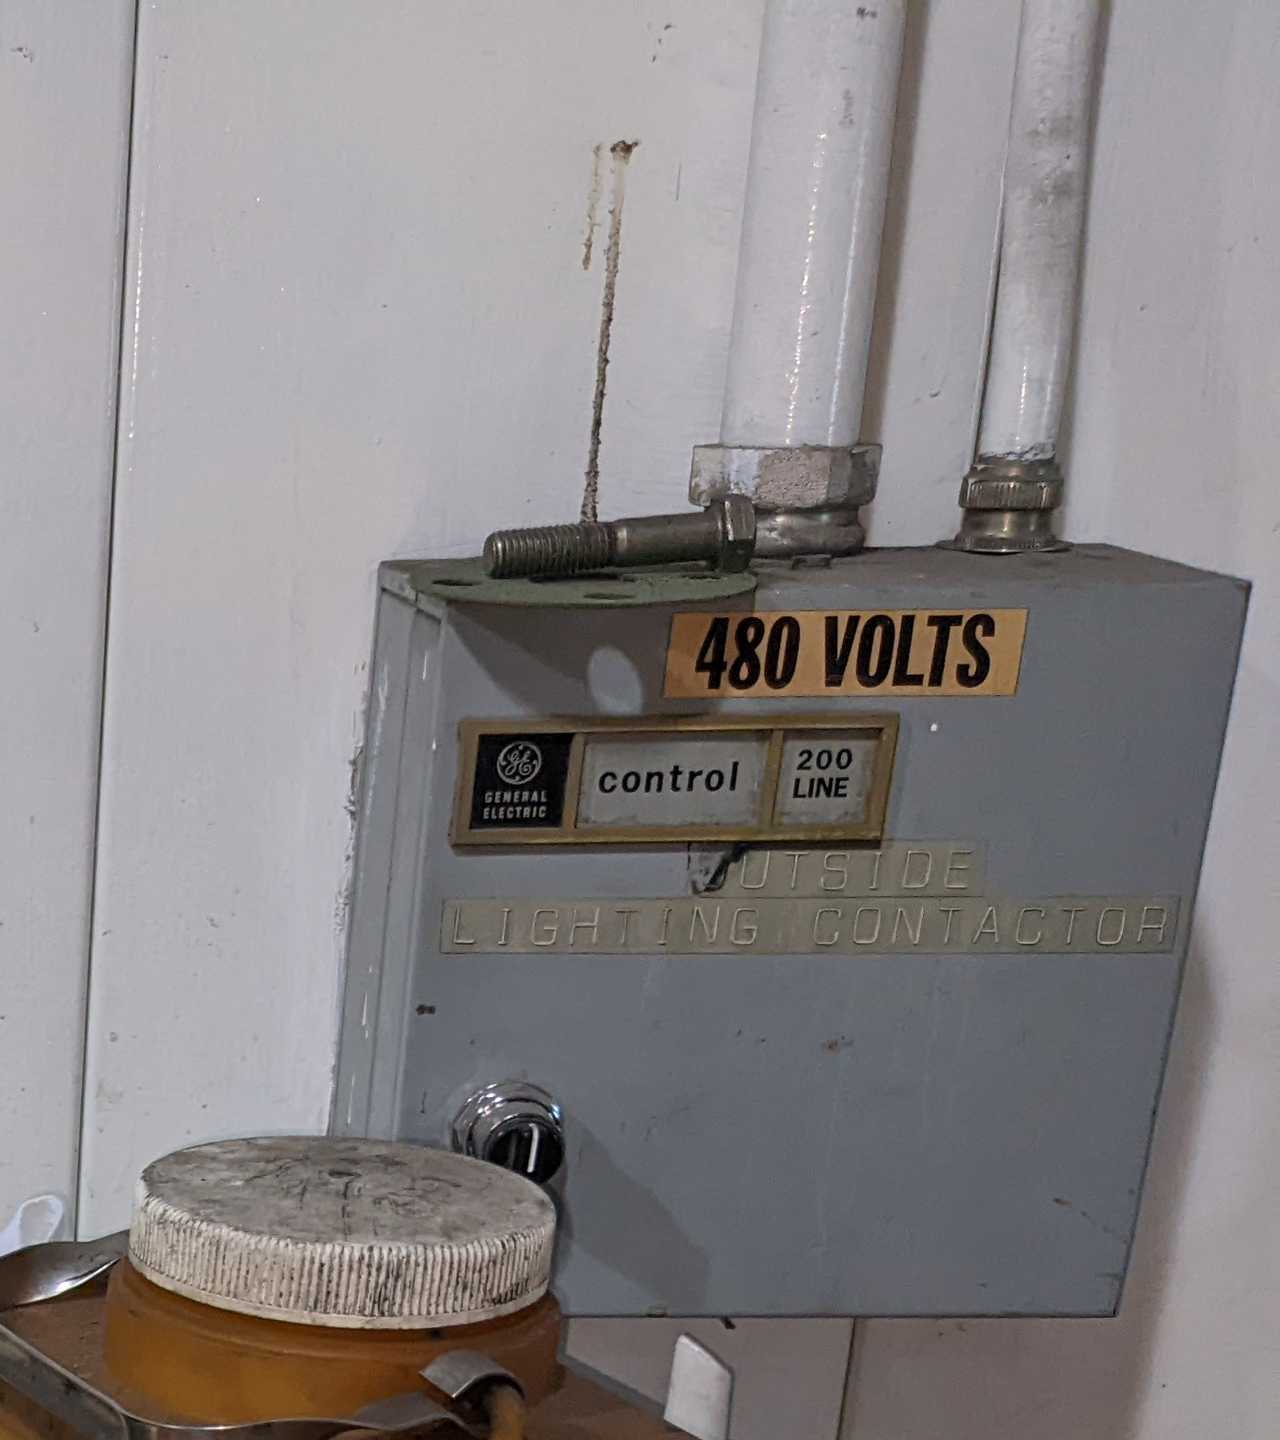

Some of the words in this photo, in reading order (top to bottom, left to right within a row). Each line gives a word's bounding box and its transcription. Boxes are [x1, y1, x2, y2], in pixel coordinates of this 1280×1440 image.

[694, 614, 802, 691] 480
[823, 612, 996, 690] VOLTS
[796, 747, 854, 772] 200
[596, 760, 740, 796] control
[791, 774, 849, 800] LINE
[484, 790, 548, 804] GENERAL
[483, 805, 548, 820] ELECTRIC
[448, 904, 760, 948] LIGHTING
[804, 904, 1170, 948] CONTACTOR
